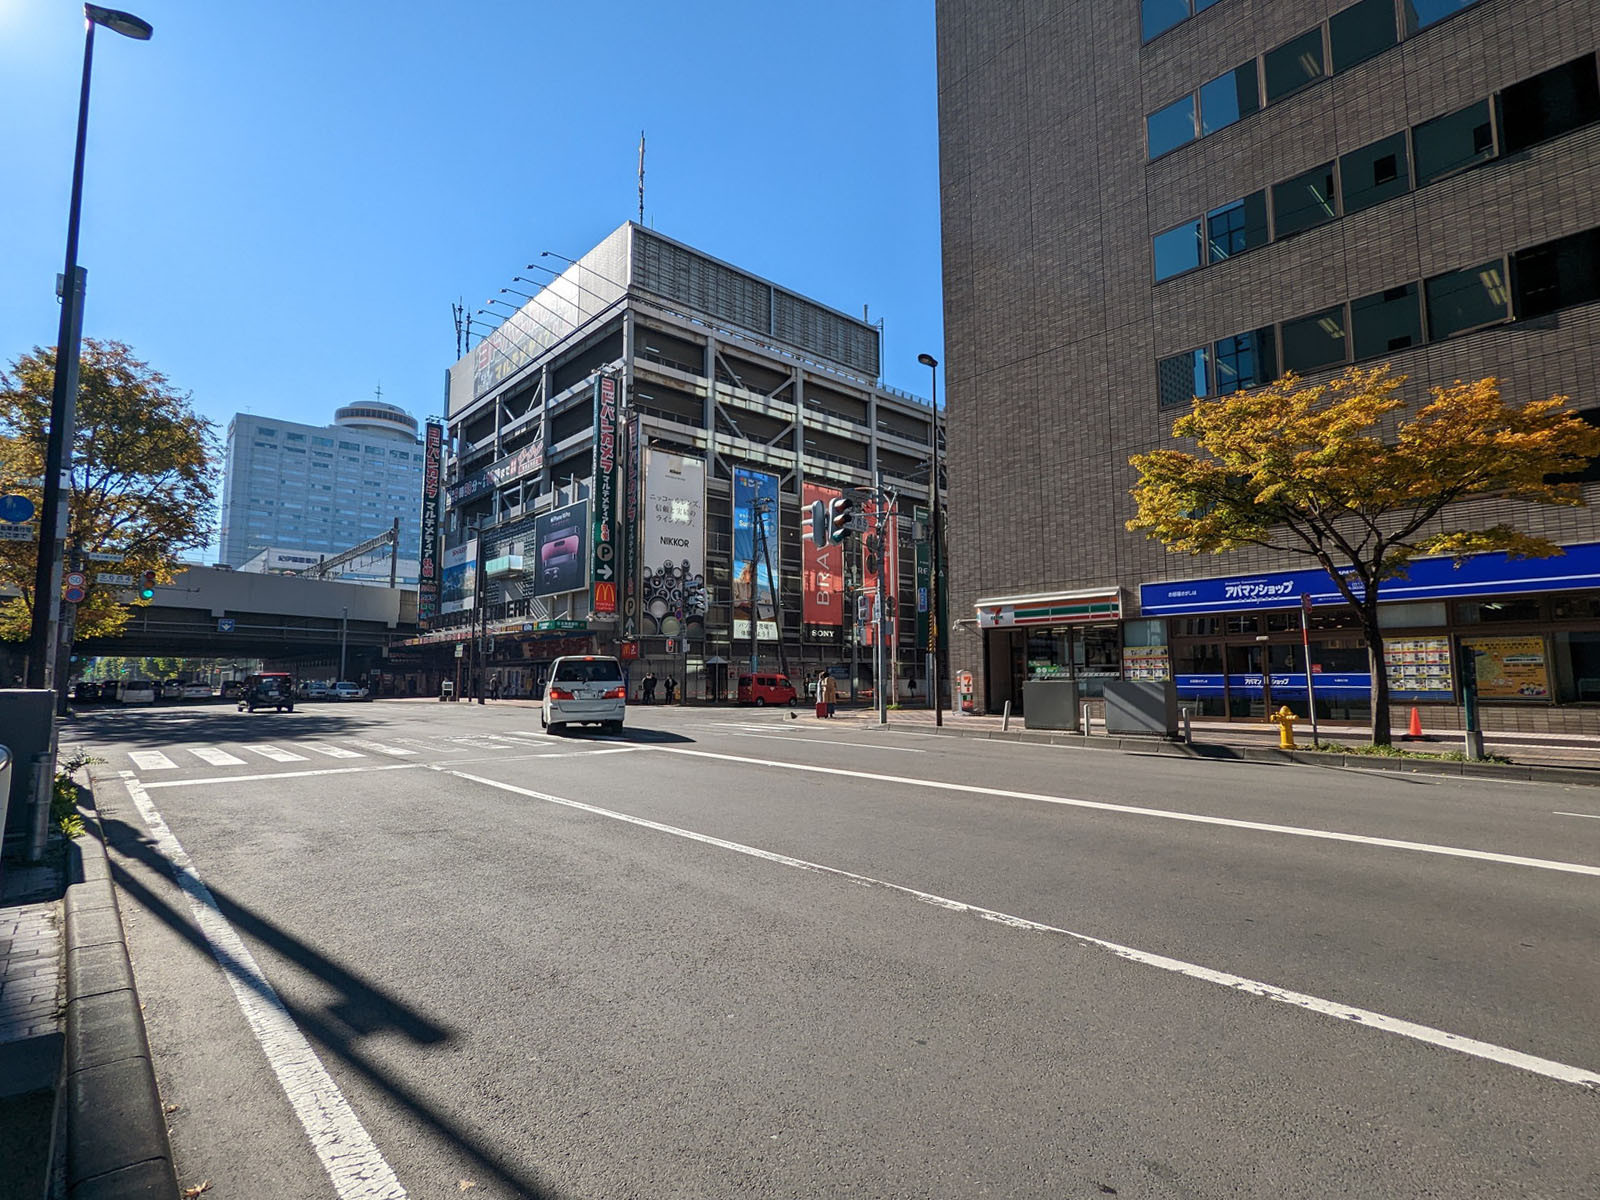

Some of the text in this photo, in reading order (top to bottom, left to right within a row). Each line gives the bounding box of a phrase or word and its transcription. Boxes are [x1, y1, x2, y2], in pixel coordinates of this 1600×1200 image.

[600, 378, 615, 474] ヨドバシカメラ
[426, 427, 441, 499] ヨドバシカメラ
[660, 536, 690, 548] NIKKOR
[1225, 580, 1294, 599] アパマンショップ
[811, 629, 835, 638] SONY
